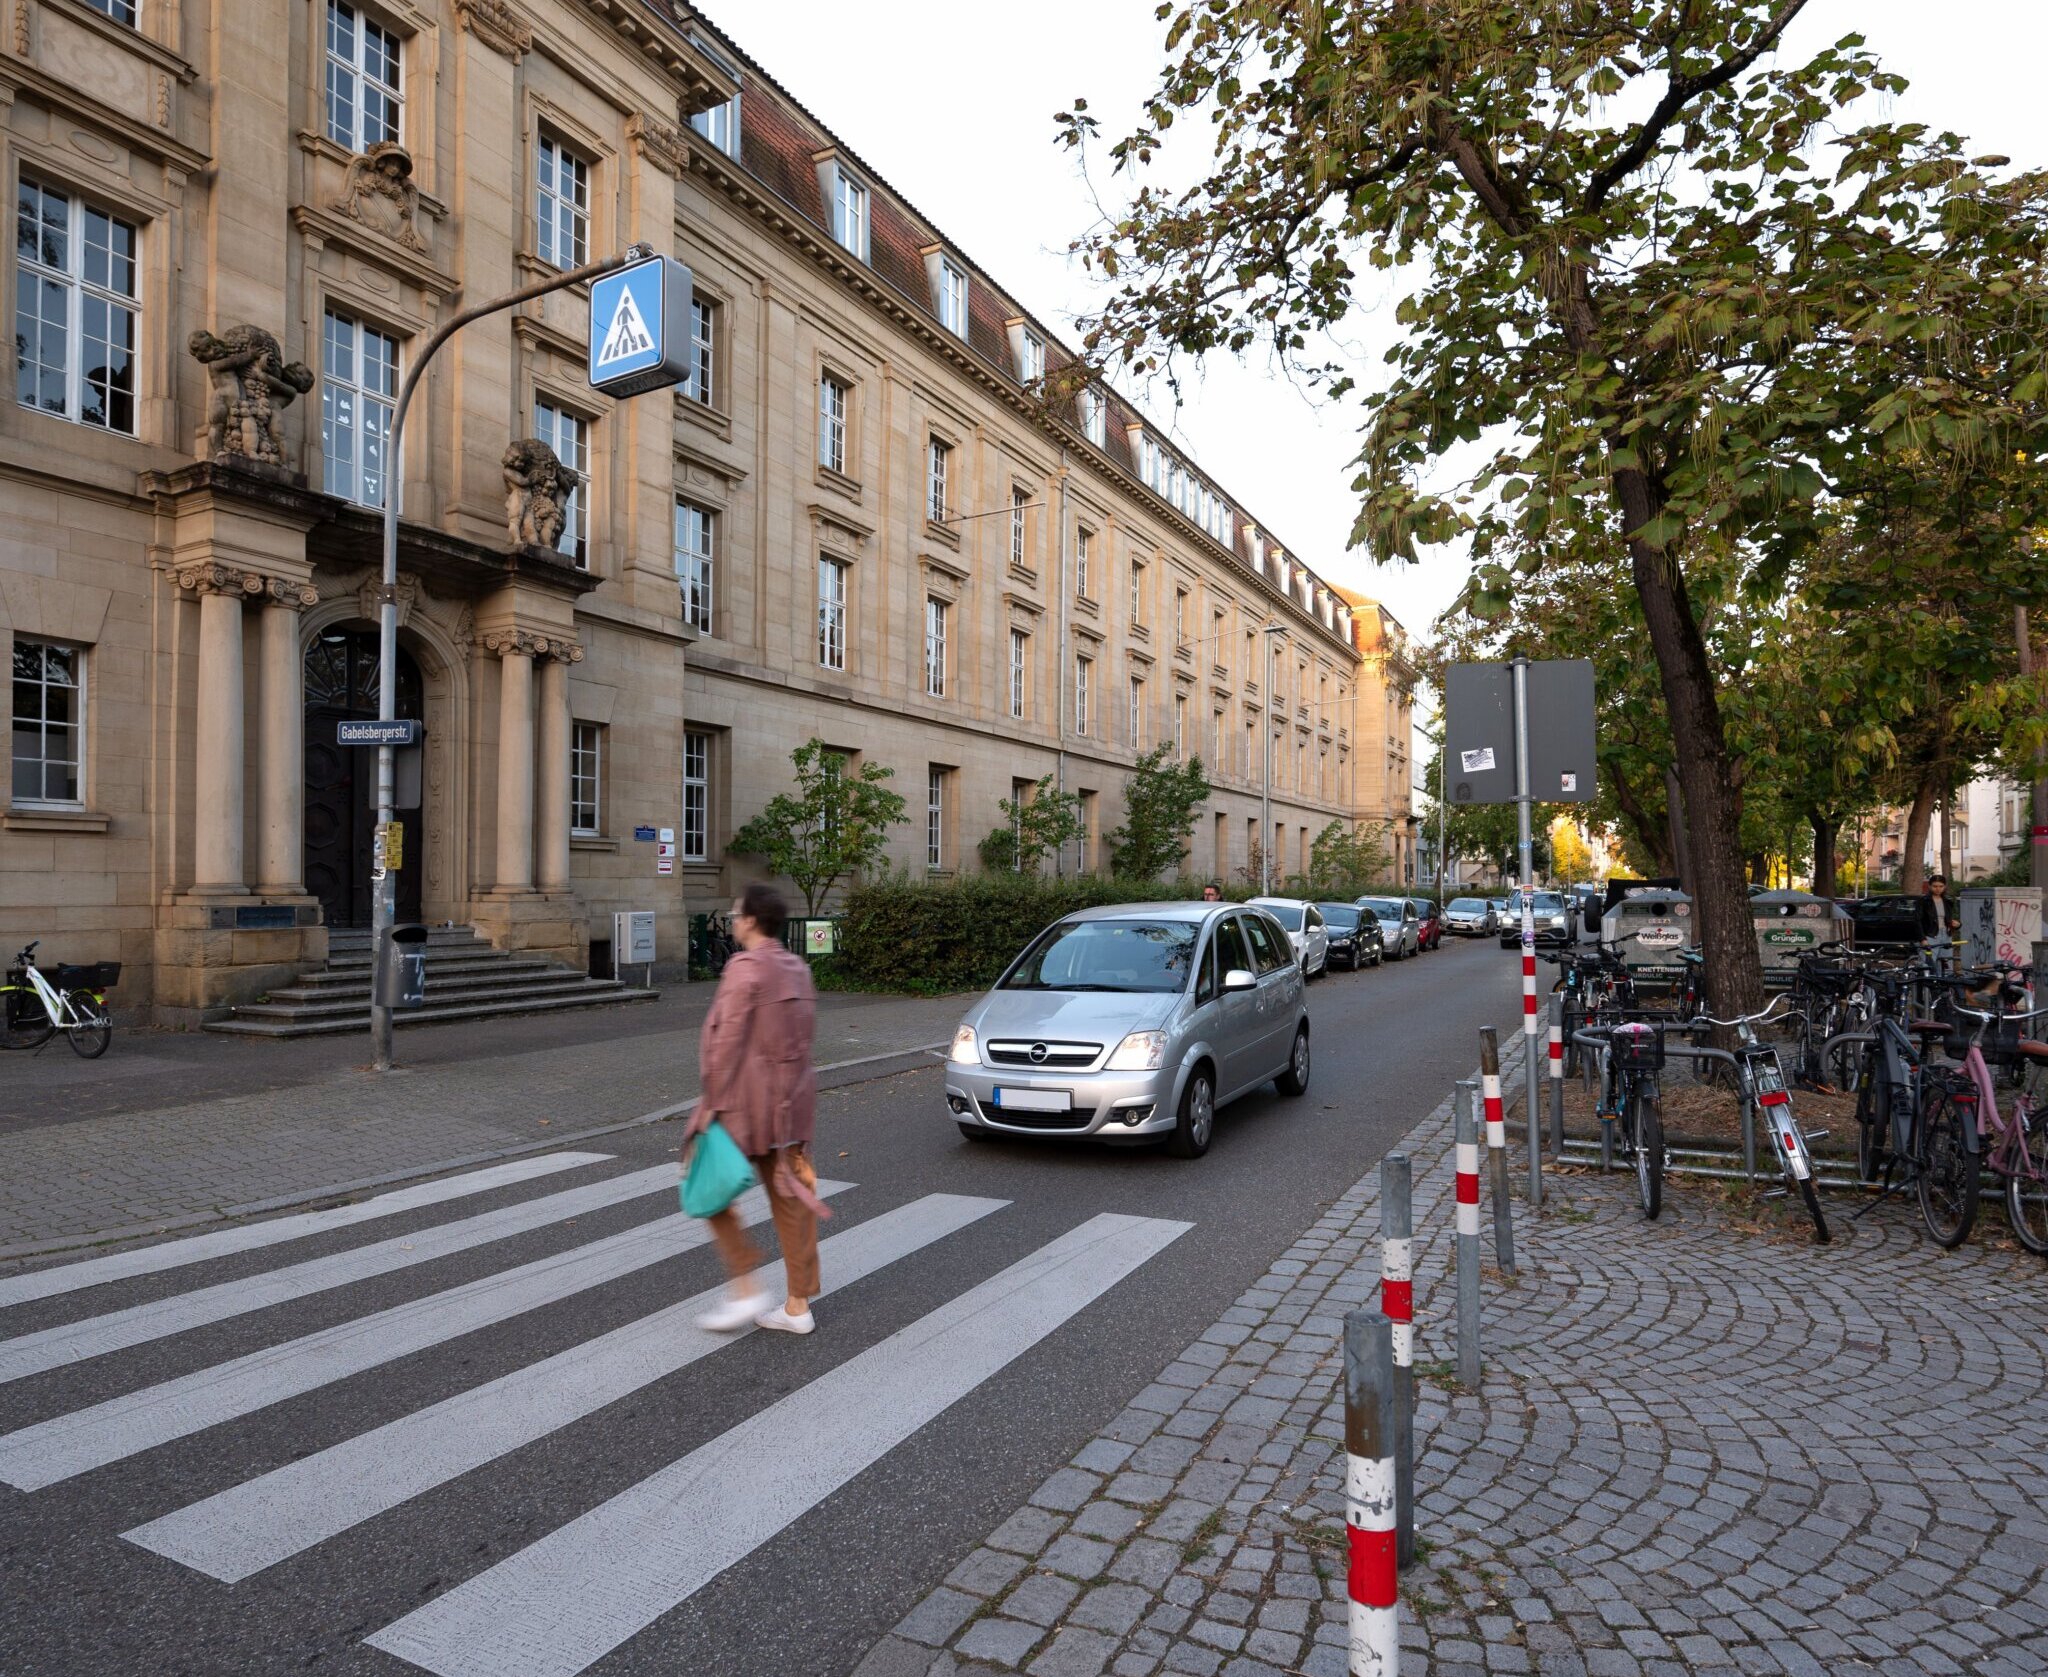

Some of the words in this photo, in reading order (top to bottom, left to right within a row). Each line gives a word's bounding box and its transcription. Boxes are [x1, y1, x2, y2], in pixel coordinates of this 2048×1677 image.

[341, 725, 408, 742] Gabelsbergerstr.
[1641, 933, 1679, 941] Weißglas
[1771, 934, 1807, 943] Grünglas
